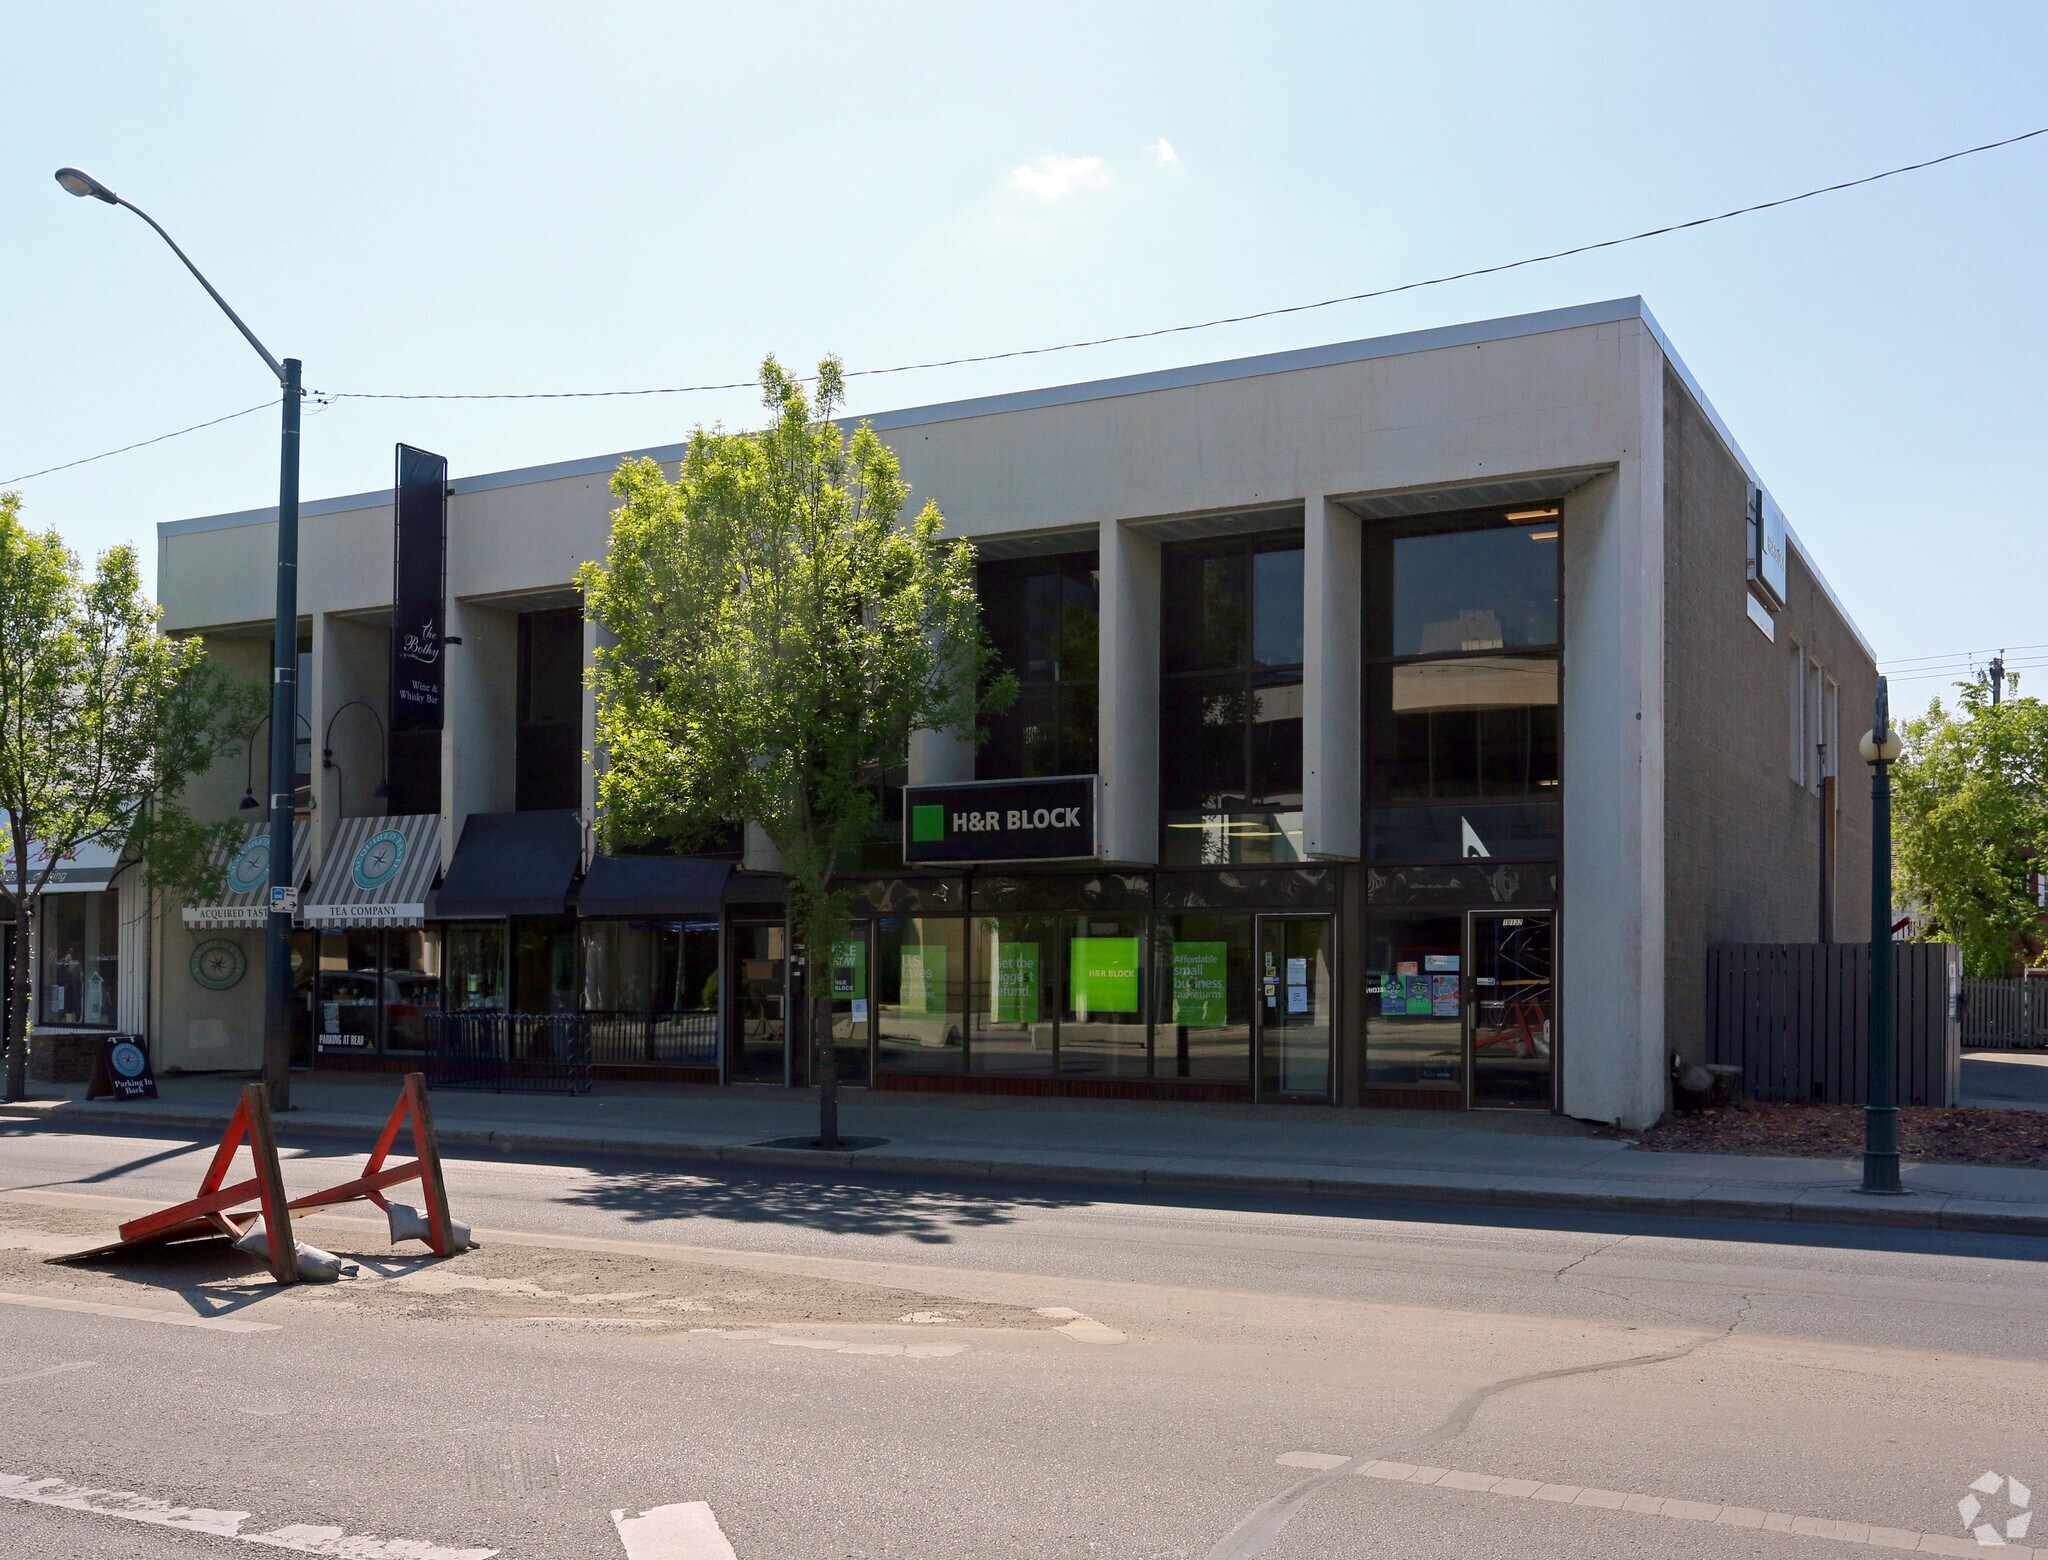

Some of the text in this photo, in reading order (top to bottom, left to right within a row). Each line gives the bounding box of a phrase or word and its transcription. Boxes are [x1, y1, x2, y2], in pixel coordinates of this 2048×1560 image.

[421, 618, 437, 640] The
[399, 633, 439, 663] Bothy
[412, 680, 438, 693] Wine &
[400, 689, 438, 704] Whisky Bar
[952, 807, 1081, 832] H&R BLOCK
[200, 909, 244, 918] ACQUIRED
[246, 908, 268, 918] TAST
[330, 905, 397, 916] TEA COMPANY
[1016, 957, 1034, 969] the
[1174, 954, 1217, 964] Affordable
[902, 967, 933, 979] taxes
[1108, 969, 1135, 978] BLOCK
[1174, 964, 1203, 976] small
[992, 985, 1031, 997] efund.
[342, 1034, 350, 1045] AT
[114, 1078, 153, 1088] Parking In
[125, 1086, 145, 1095] Back
